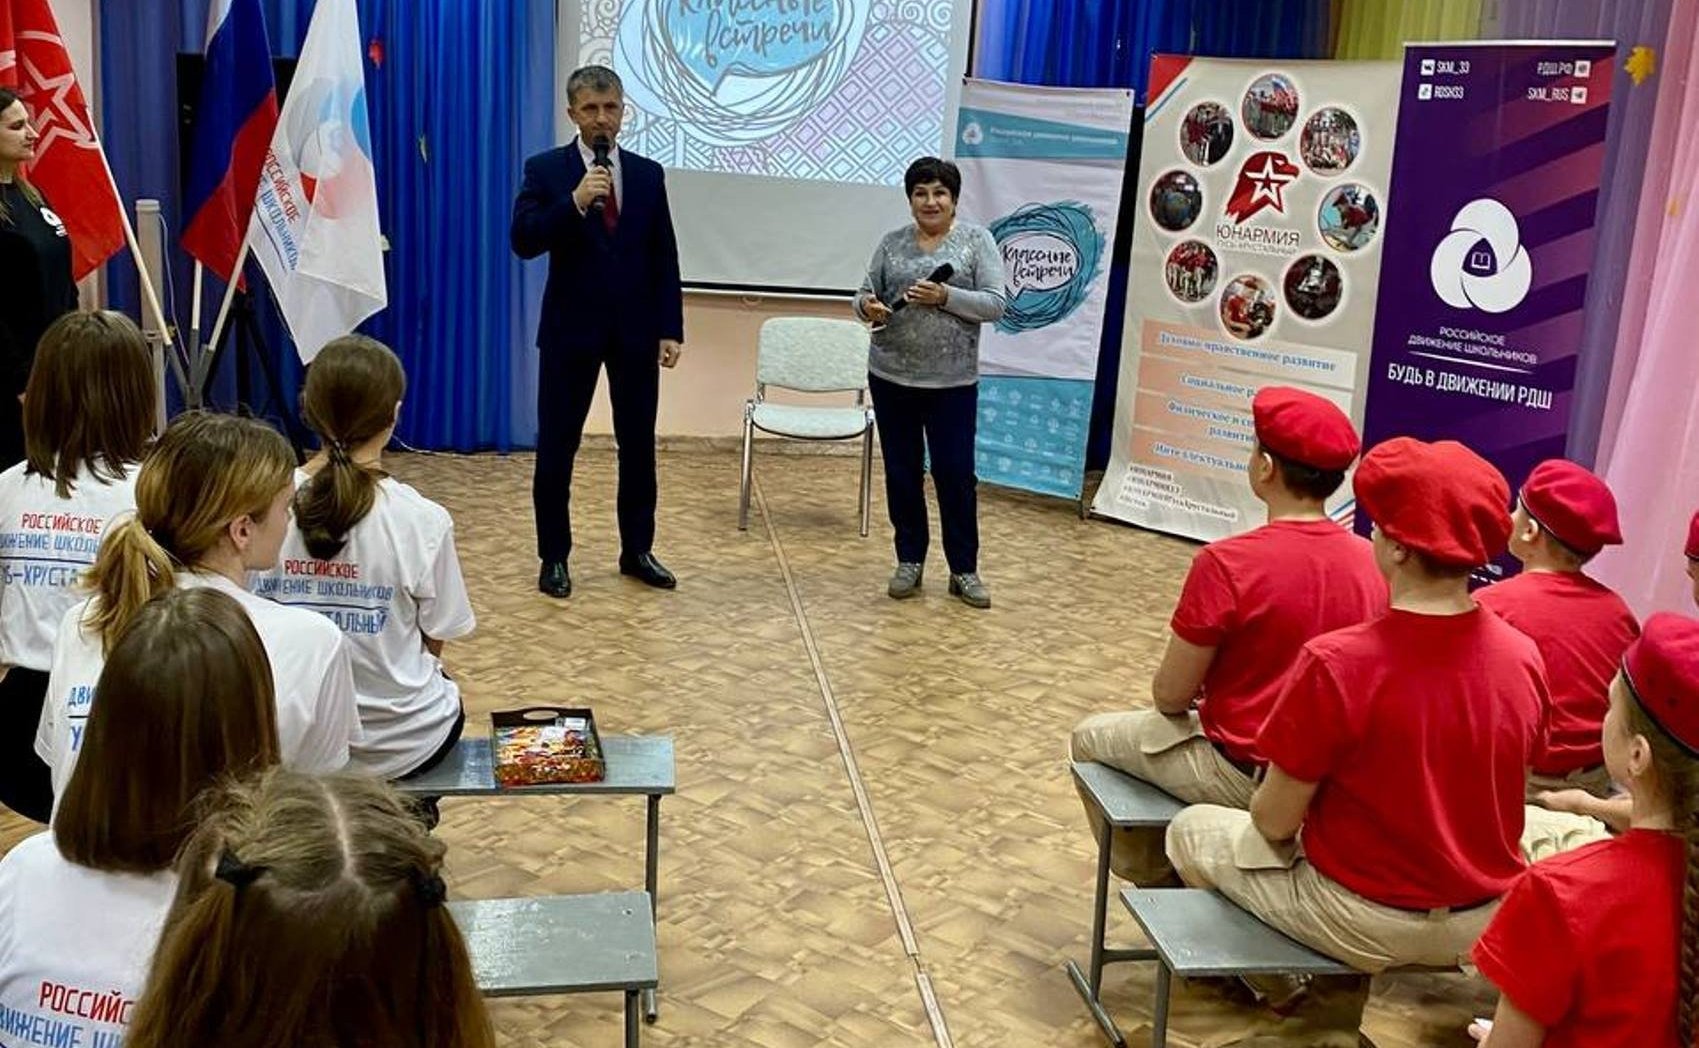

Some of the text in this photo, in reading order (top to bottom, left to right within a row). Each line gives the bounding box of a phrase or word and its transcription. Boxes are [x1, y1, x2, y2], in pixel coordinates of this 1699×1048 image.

[1216, 225, 1300, 246] ЮНАРМИЯ
[1439, 326, 1505, 346] РОССИЙСКОЕ
[1407, 334, 1537, 365] ДВИЖЕНИЕ ШКОЛЬНИКОВ
[1387, 362, 1552, 410] БУДЬ В ДВИЖЕНИИ РДШ
[22, 512, 102, 534] РОССИЙСКОЕ
[285, 559, 360, 580] РОССИЙСКОЕ
